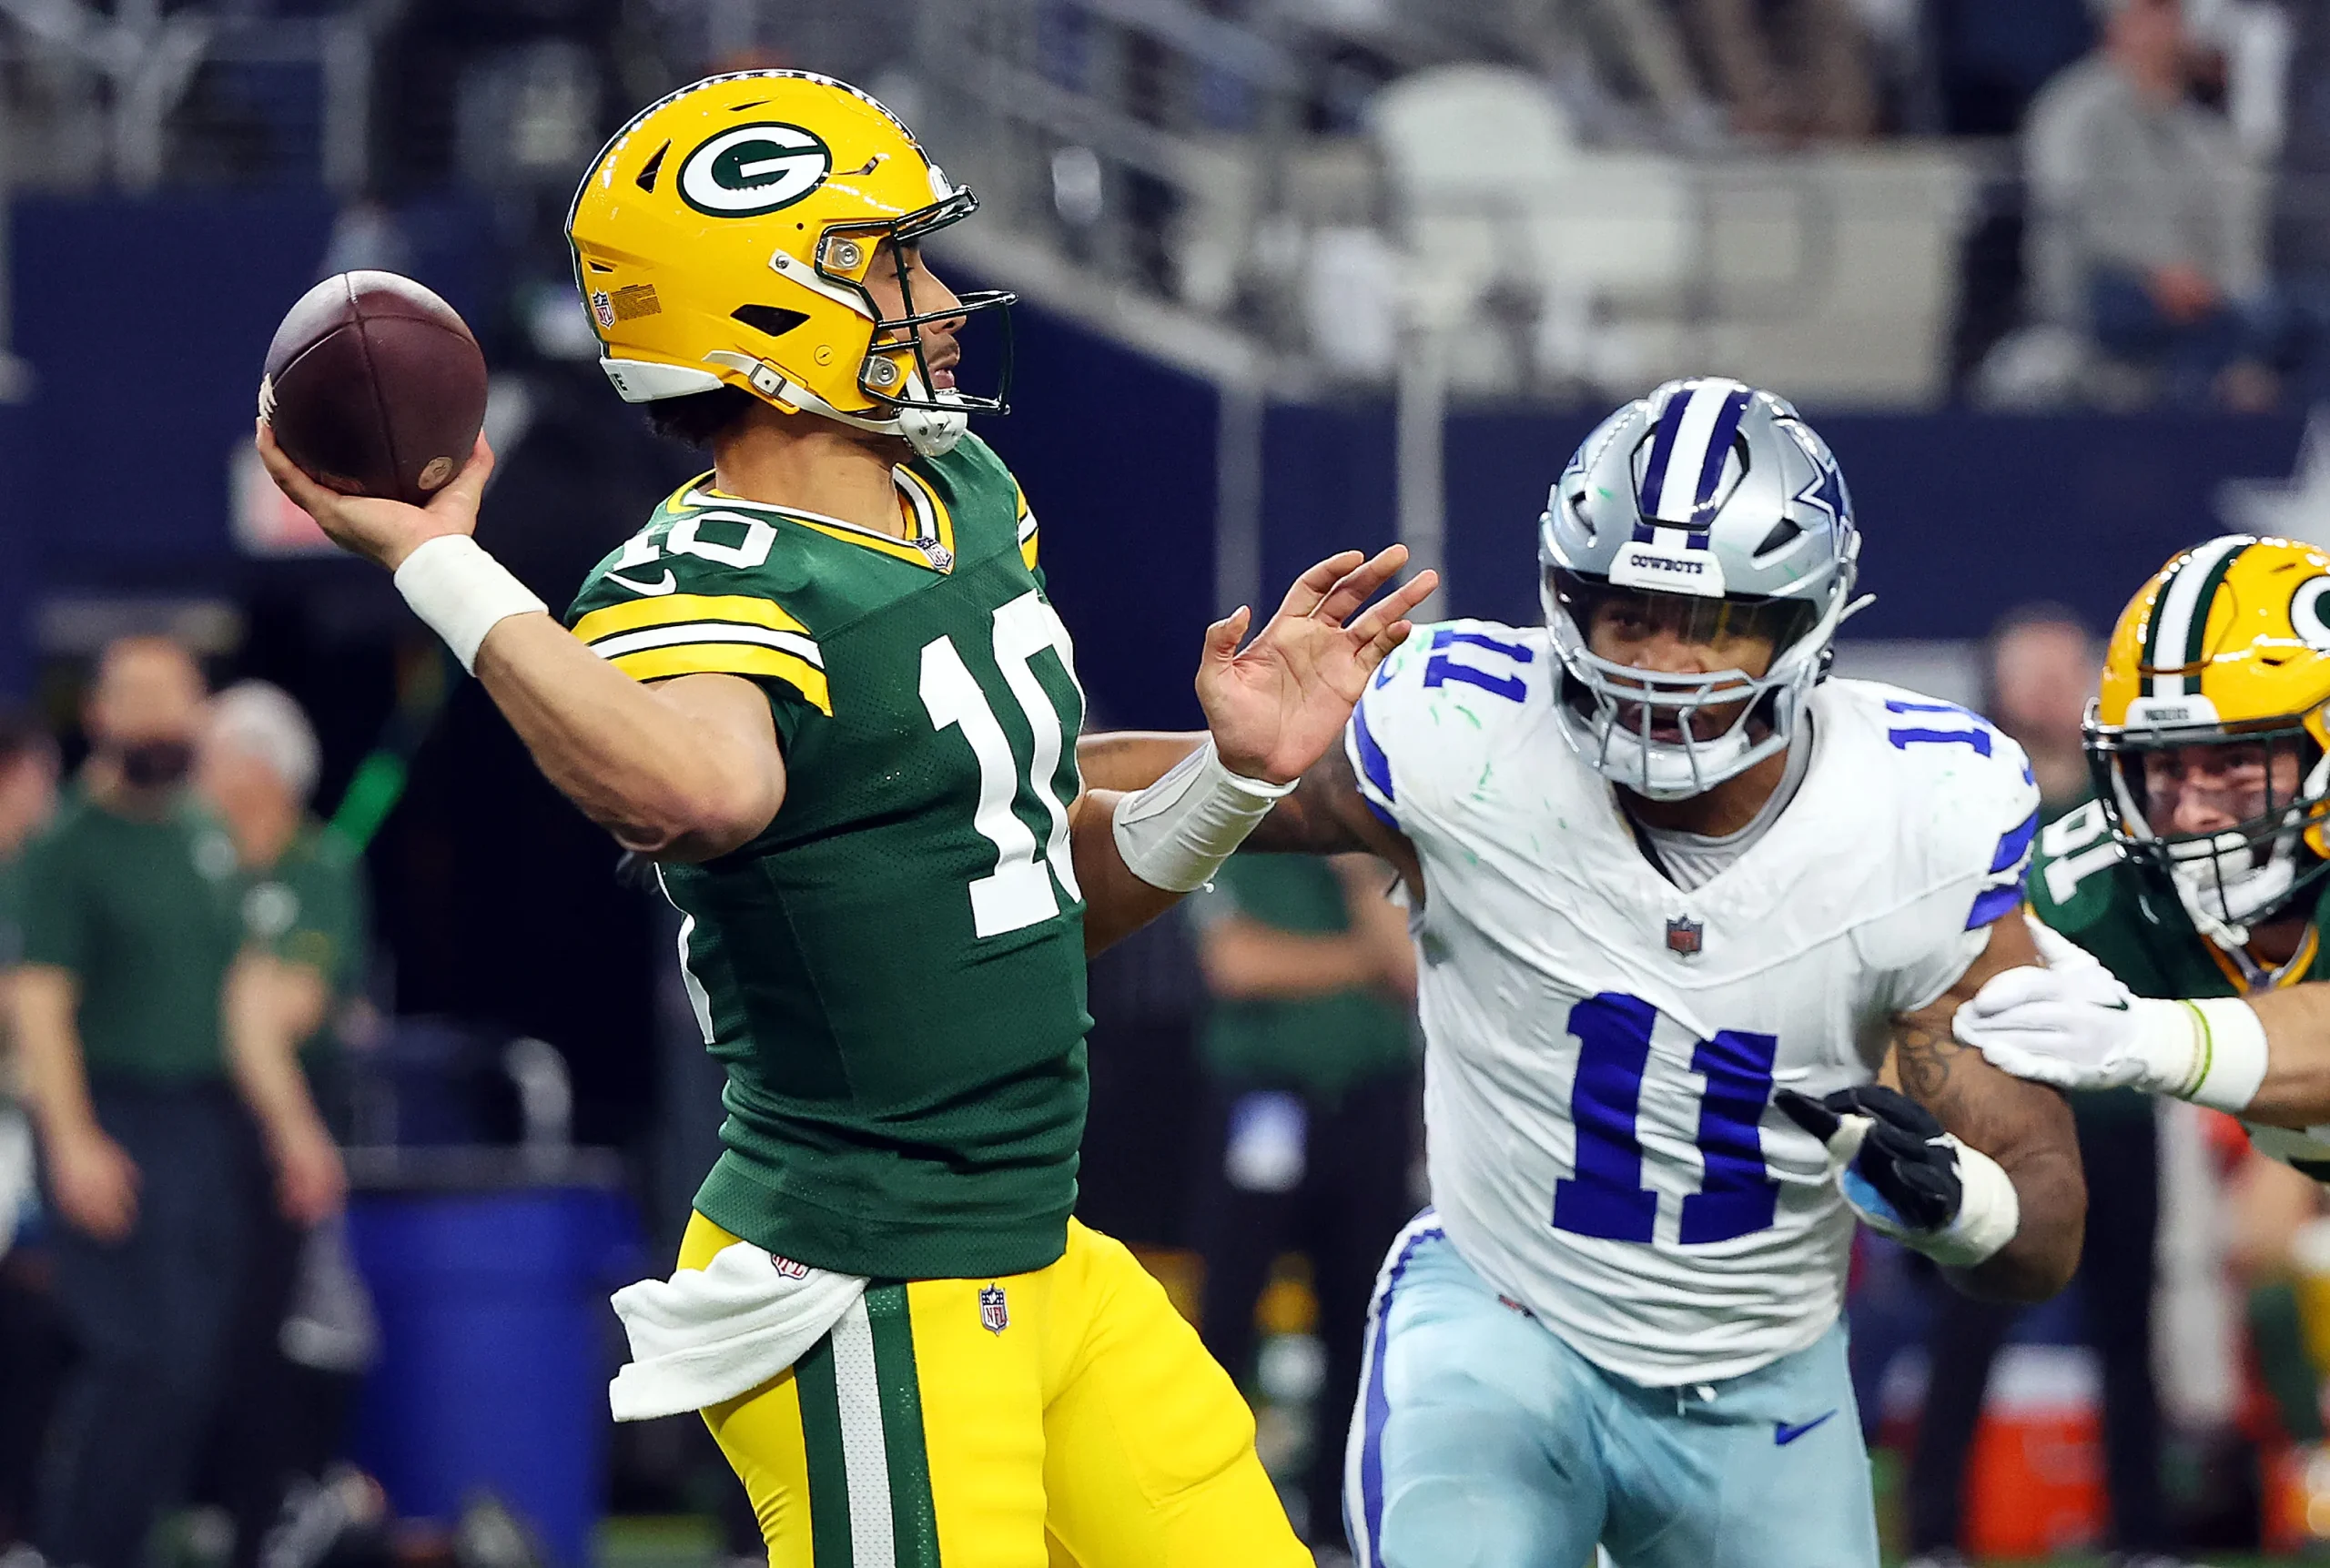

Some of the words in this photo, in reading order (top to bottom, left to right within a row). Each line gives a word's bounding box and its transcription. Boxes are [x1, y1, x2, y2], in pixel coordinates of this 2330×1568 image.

[1631, 554, 1702, 574] COWBOYS
[1423, 629, 1534, 703] 11
[1885, 698, 1991, 758] 11
[917, 588, 1085, 939] 10
[1552, 992, 1780, 1244] 11
[986, 1306, 1008, 1326] NFL
